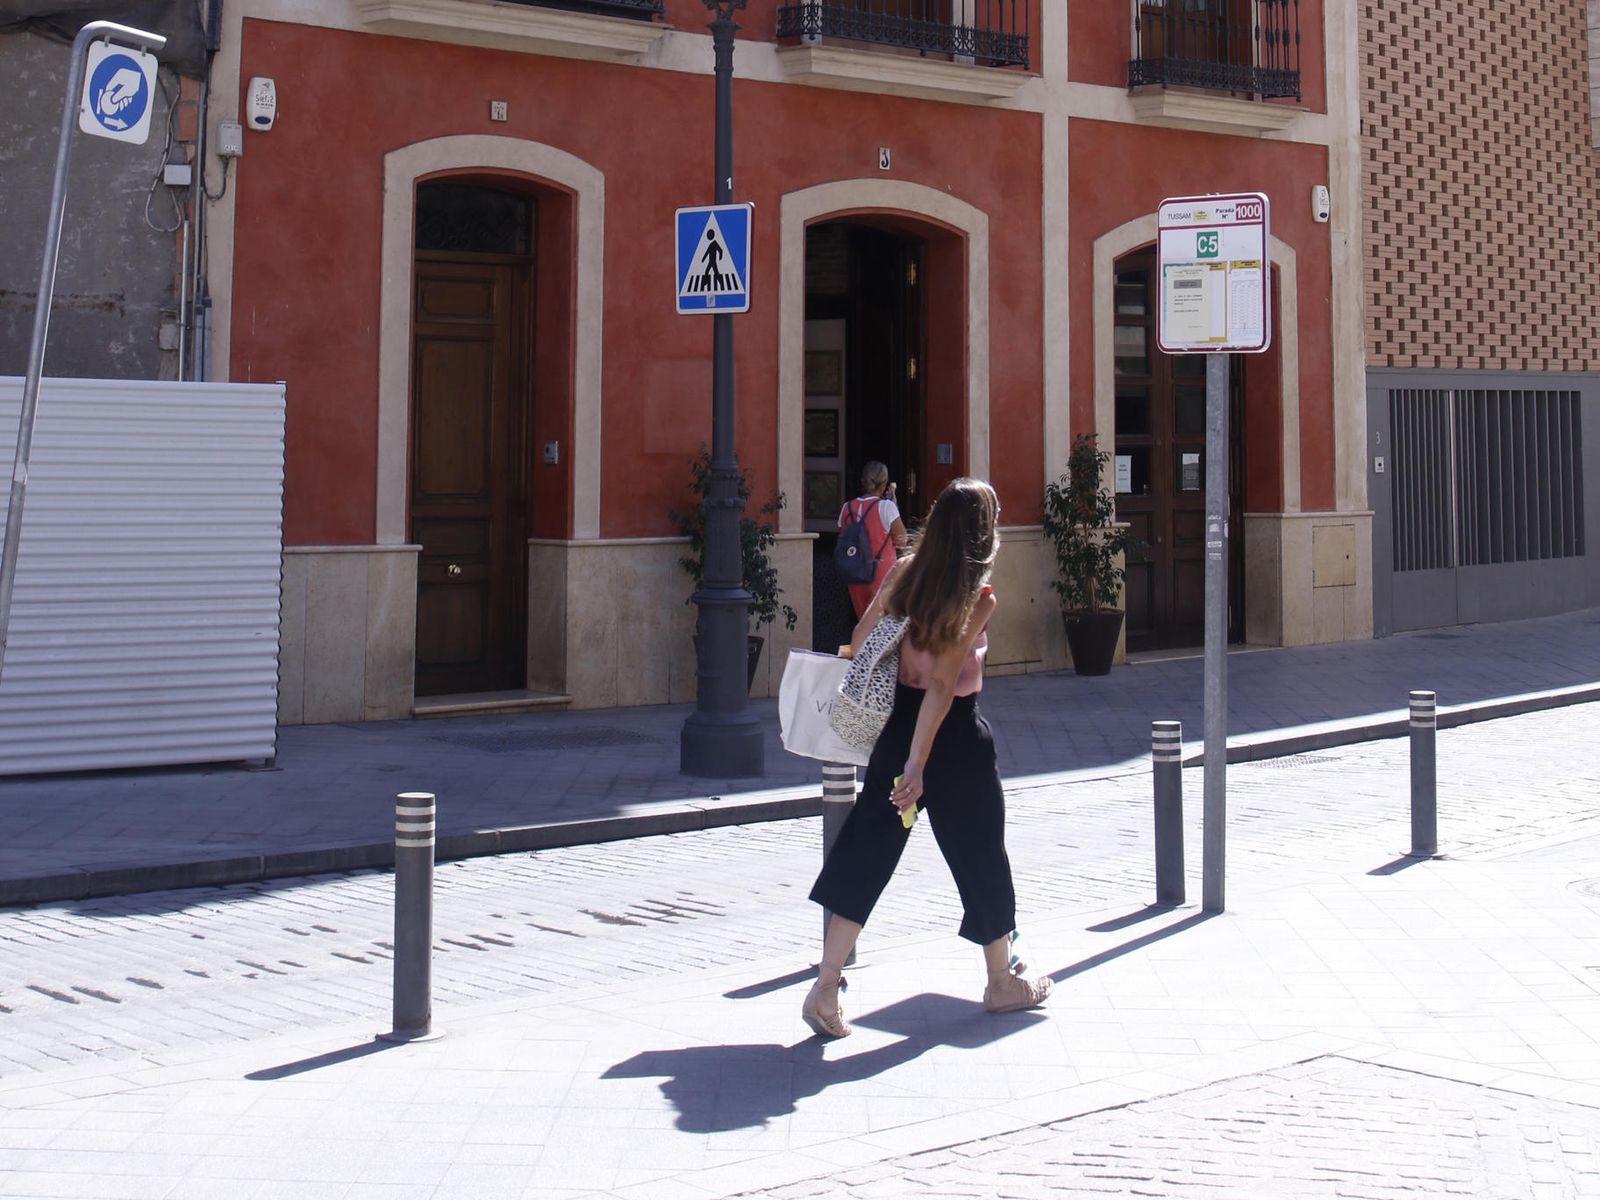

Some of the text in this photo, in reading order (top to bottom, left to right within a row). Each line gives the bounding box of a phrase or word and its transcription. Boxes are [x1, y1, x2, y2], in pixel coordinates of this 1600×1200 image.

[726, 177, 732, 190] 1
[1236, 204, 1261, 219] 1000
[1198, 236, 1218, 253] C5
[1375, 431, 1381, 445] 3
